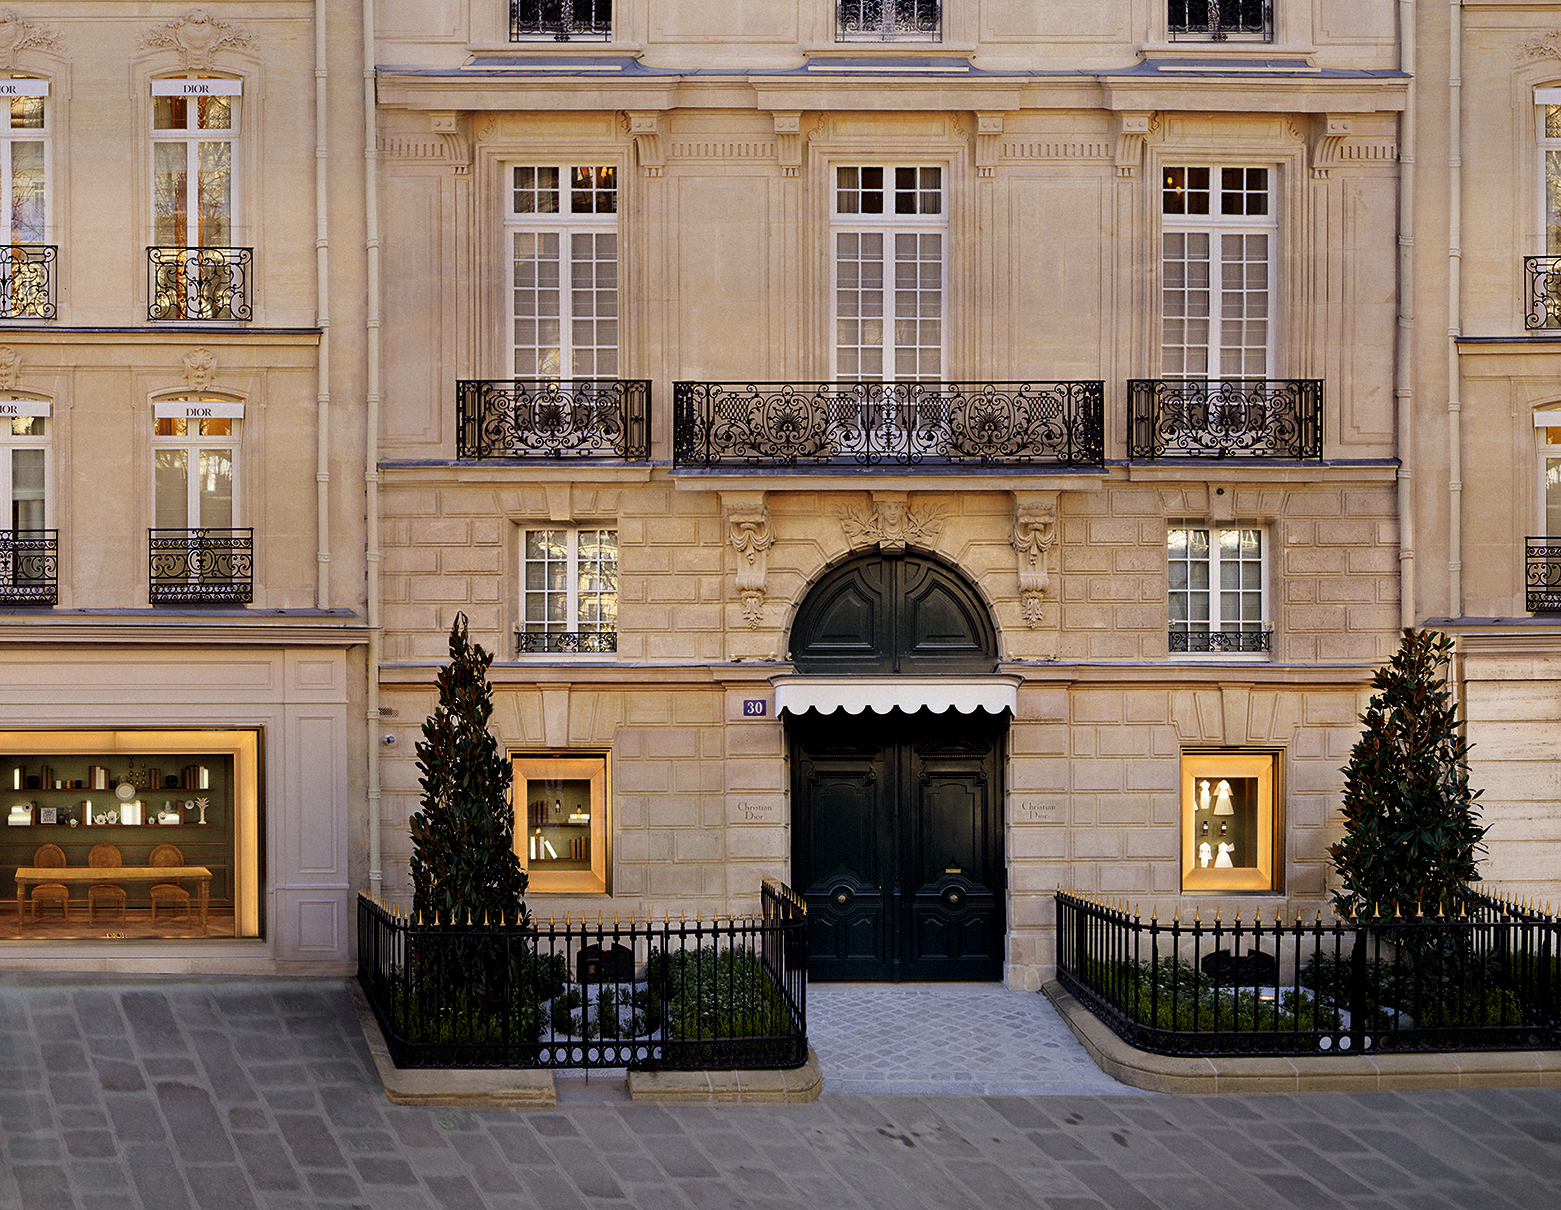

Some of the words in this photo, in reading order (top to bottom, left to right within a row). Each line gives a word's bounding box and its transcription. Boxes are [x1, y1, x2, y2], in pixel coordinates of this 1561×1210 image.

[184, 84, 209, 93] DIOR
[186, 408, 212, 417] DIOR
[747, 701, 763, 714] 30
[737, 802, 772, 811] Christian
[1021, 801, 1056, 810] Christian
[745, 811, 764, 820] Dior
[1029, 810, 1048, 819] Dior
